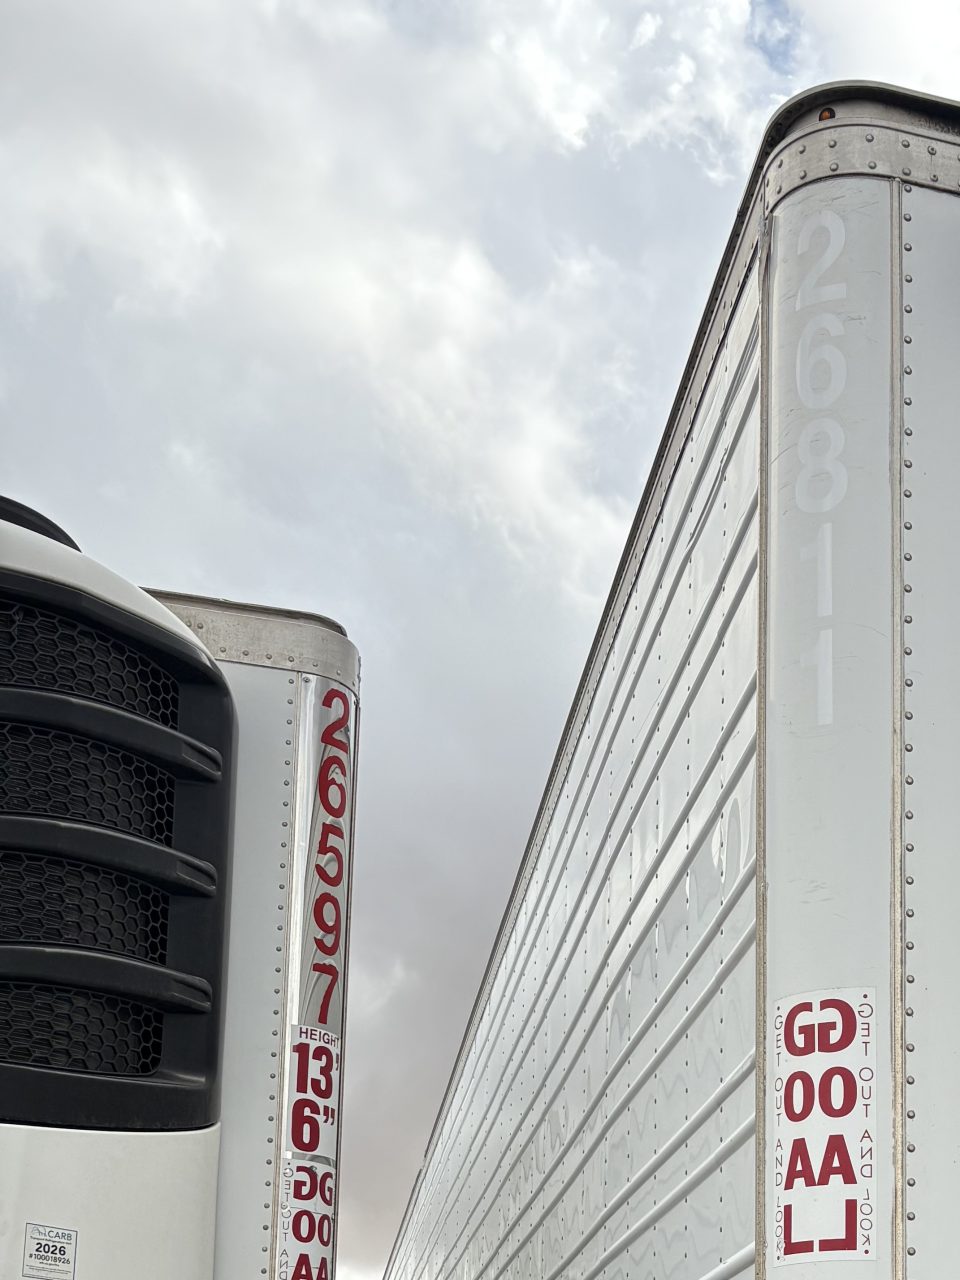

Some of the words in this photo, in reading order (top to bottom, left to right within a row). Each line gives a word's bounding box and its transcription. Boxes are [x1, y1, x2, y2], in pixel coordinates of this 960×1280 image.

[794, 208, 849, 726] 26811
[312, 687, 350, 1025] 26597
[299, 1027, 340, 1048] HEIGHT
[774, 1014, 783, 1067] GET
[774, 1077, 783, 1127] OUT
[775, 1138, 783, 1187] AND
[35, 1242, 66, 1256] 2026
[47, 1230, 72, 1241] CARB
